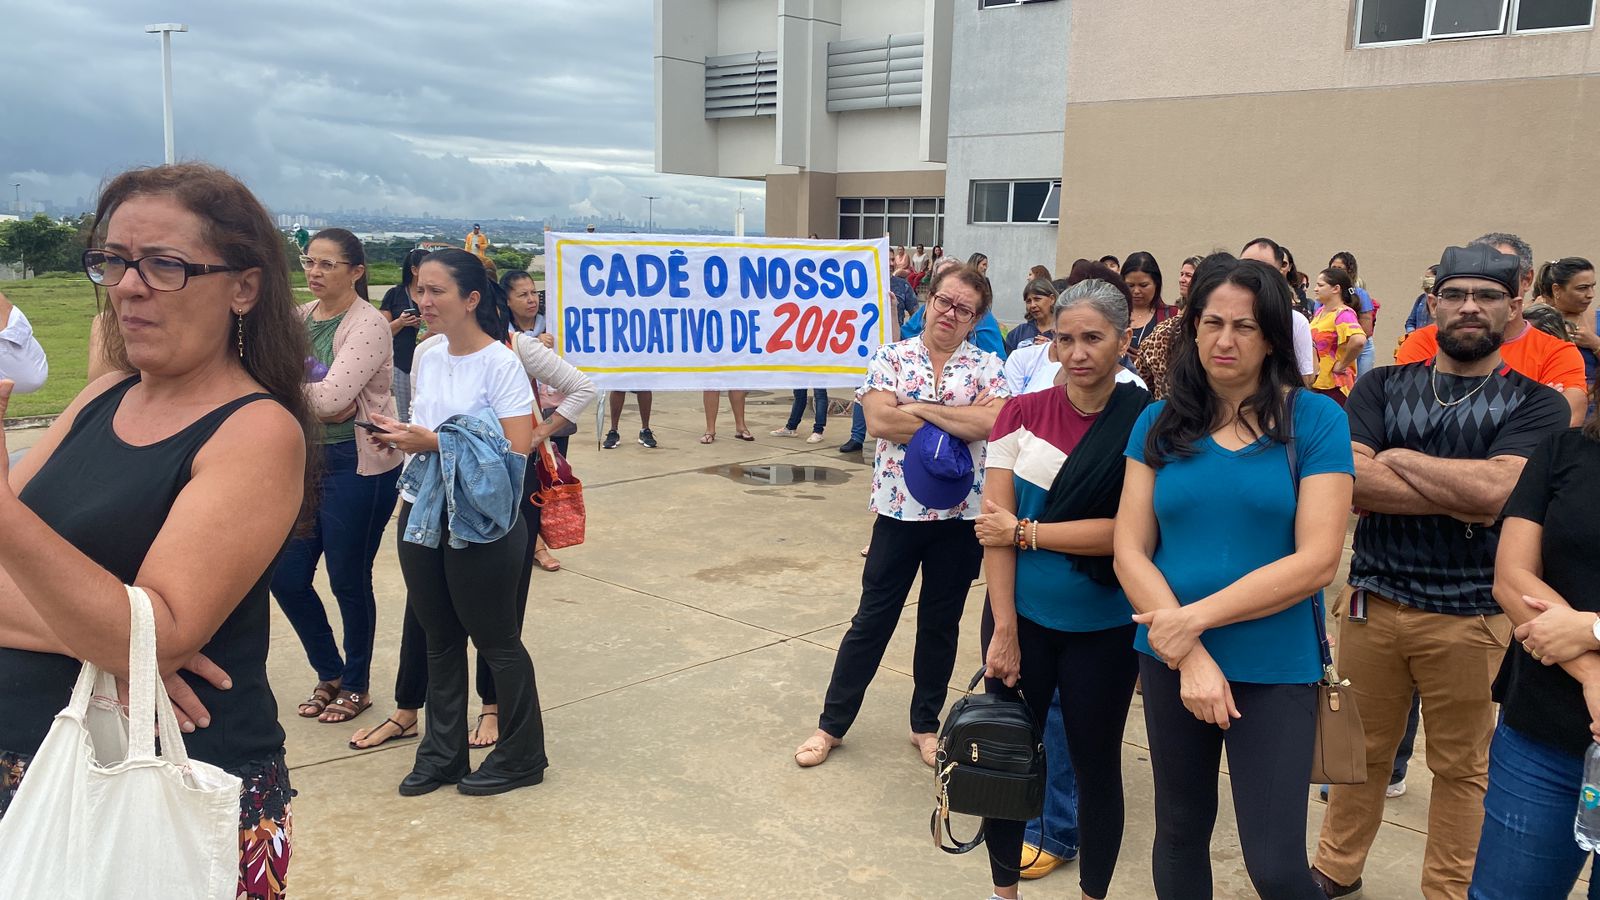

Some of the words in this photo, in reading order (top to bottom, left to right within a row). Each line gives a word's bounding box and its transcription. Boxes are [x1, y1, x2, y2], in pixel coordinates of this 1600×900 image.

[580, 249, 691, 299] CADÊ
[704, 256, 729, 299] O
[739, 256, 869, 300] NOSSO
[565, 306, 724, 354] RETROATIVO
[730, 309, 763, 354] DE
[766, 302, 879, 357] 2015?
